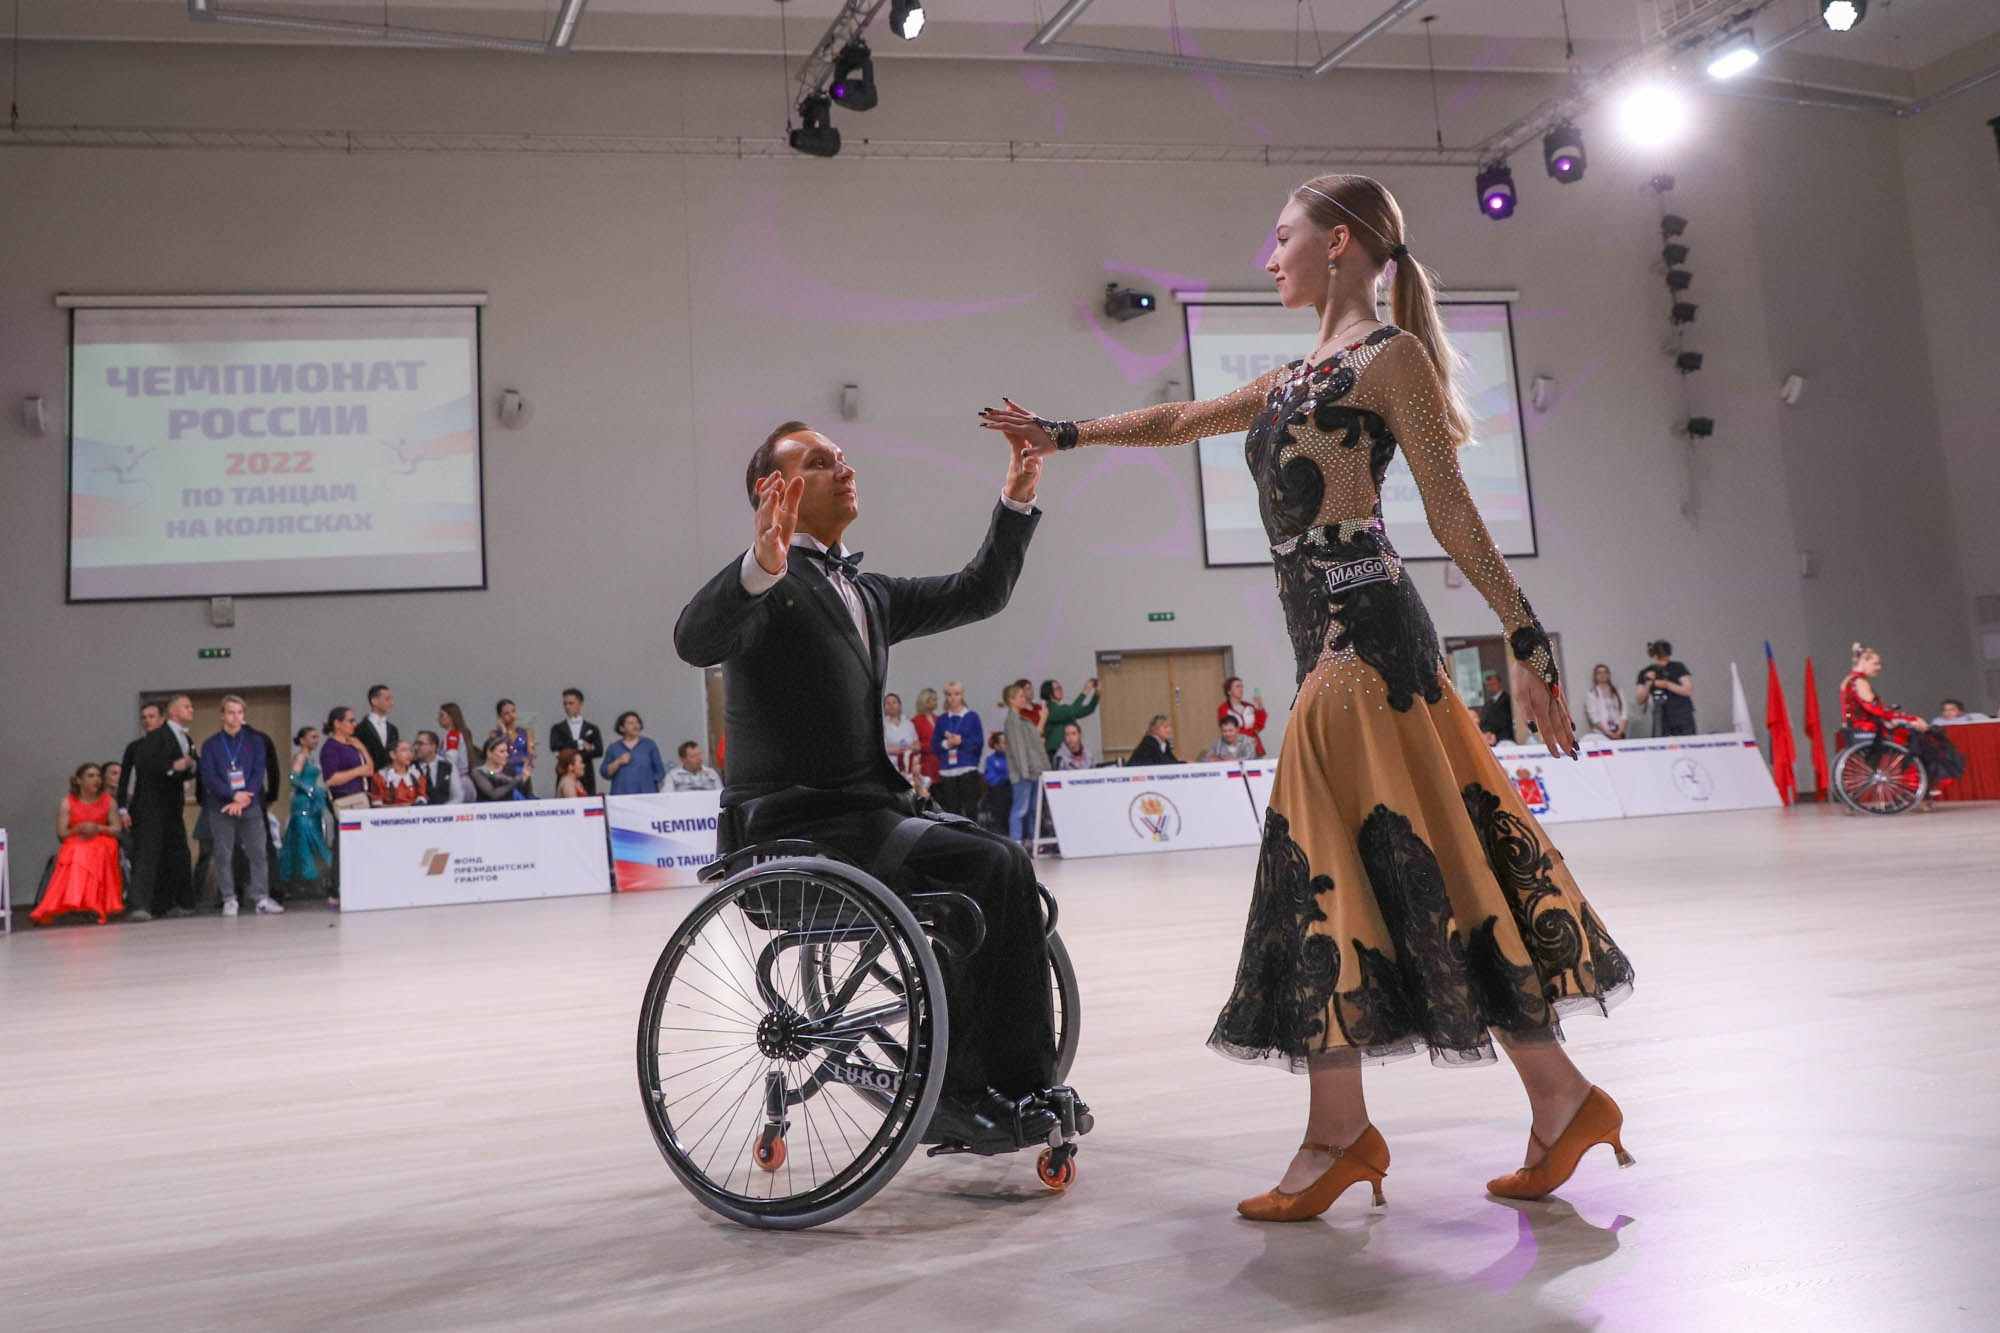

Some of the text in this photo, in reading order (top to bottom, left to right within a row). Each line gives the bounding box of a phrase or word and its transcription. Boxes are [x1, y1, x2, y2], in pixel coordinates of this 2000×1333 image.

[105, 360, 426, 397] ЧЕМПИОНАТ
[167, 405, 369, 440] РОССИИ
[225, 451, 315, 476] 2022
[181, 483, 358, 508] ПО ТАНЦАМ
[165, 513, 374, 539] НА КОЛЯСКАХ
[422, 815, 454, 824] РОССИИ
[476, 812, 487, 821] ПО
[489, 810, 521, 819] ТАНЦАМ
[523, 810, 533, 818] НА
[651, 817, 717, 834] ЧЕМПИО
[454, 857, 483, 865] ФОНД
[656, 855, 674, 868] ПО
